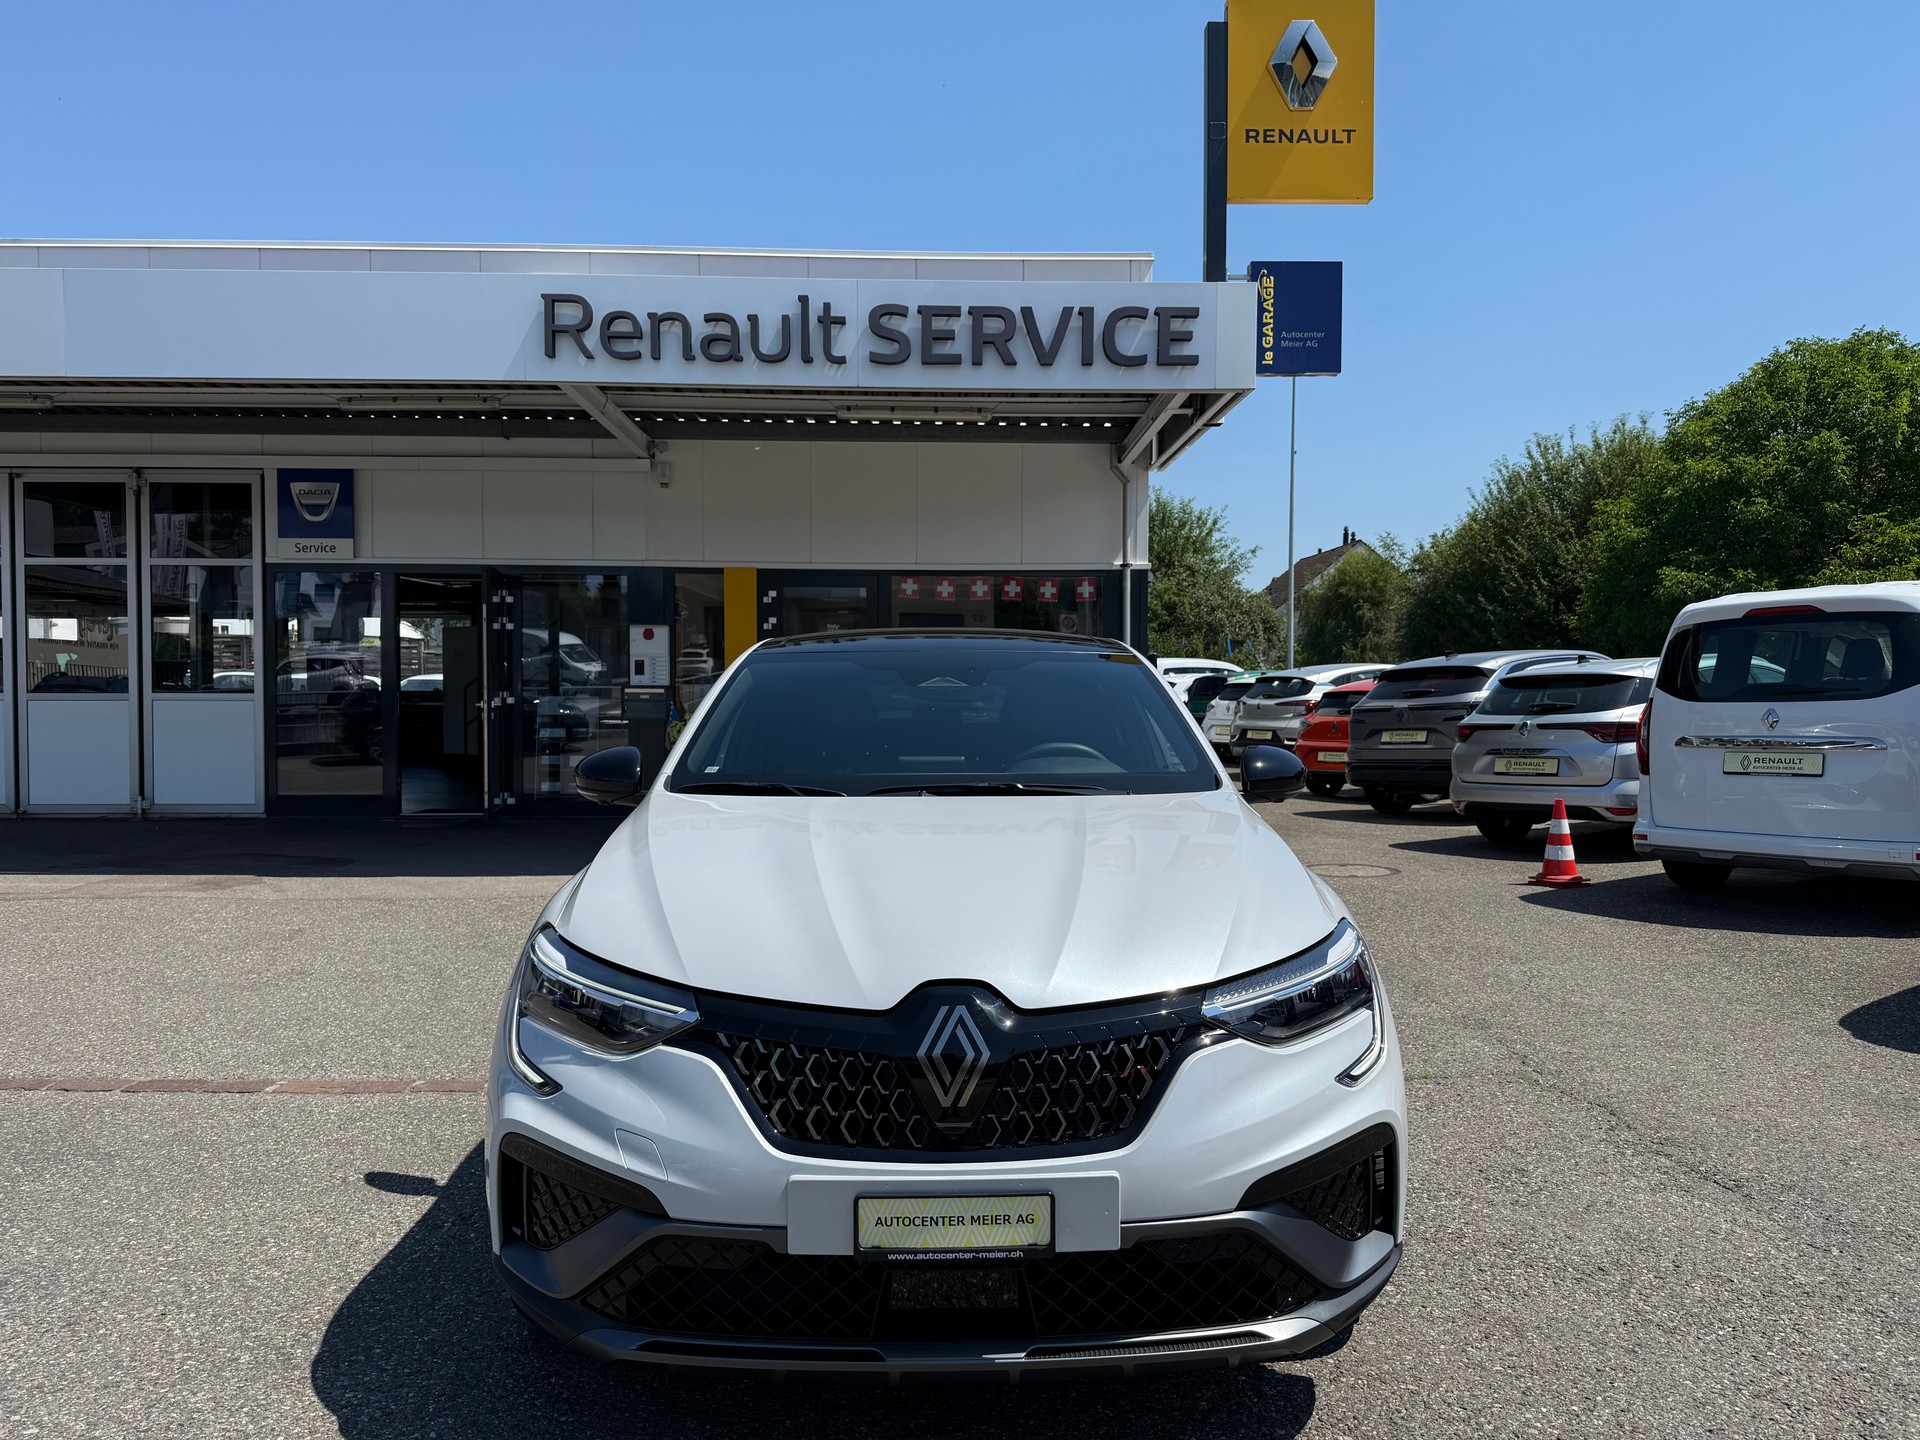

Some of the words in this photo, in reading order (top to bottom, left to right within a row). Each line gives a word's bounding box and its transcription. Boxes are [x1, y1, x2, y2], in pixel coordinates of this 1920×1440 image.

[1244, 128, 1357, 144] RENAULT
[1262, 276, 1275, 349] GARAGE
[540, 293, 847, 364] Renault
[868, 303, 1200, 367] SERVICE
[1262, 351, 1274, 365] le
[298, 488, 332, 496] DACIA
[294, 542, 337, 553] Service
[1753, 757, 1804, 765] RENAULT
[874, 1215, 965, 1227] AUTOCENTER
[970, 1214, 1011, 1226] MEIER
[1016, 1213, 1035, 1225] AG
[887, 1250, 1024, 1260] www.autocenter-meier.ch
